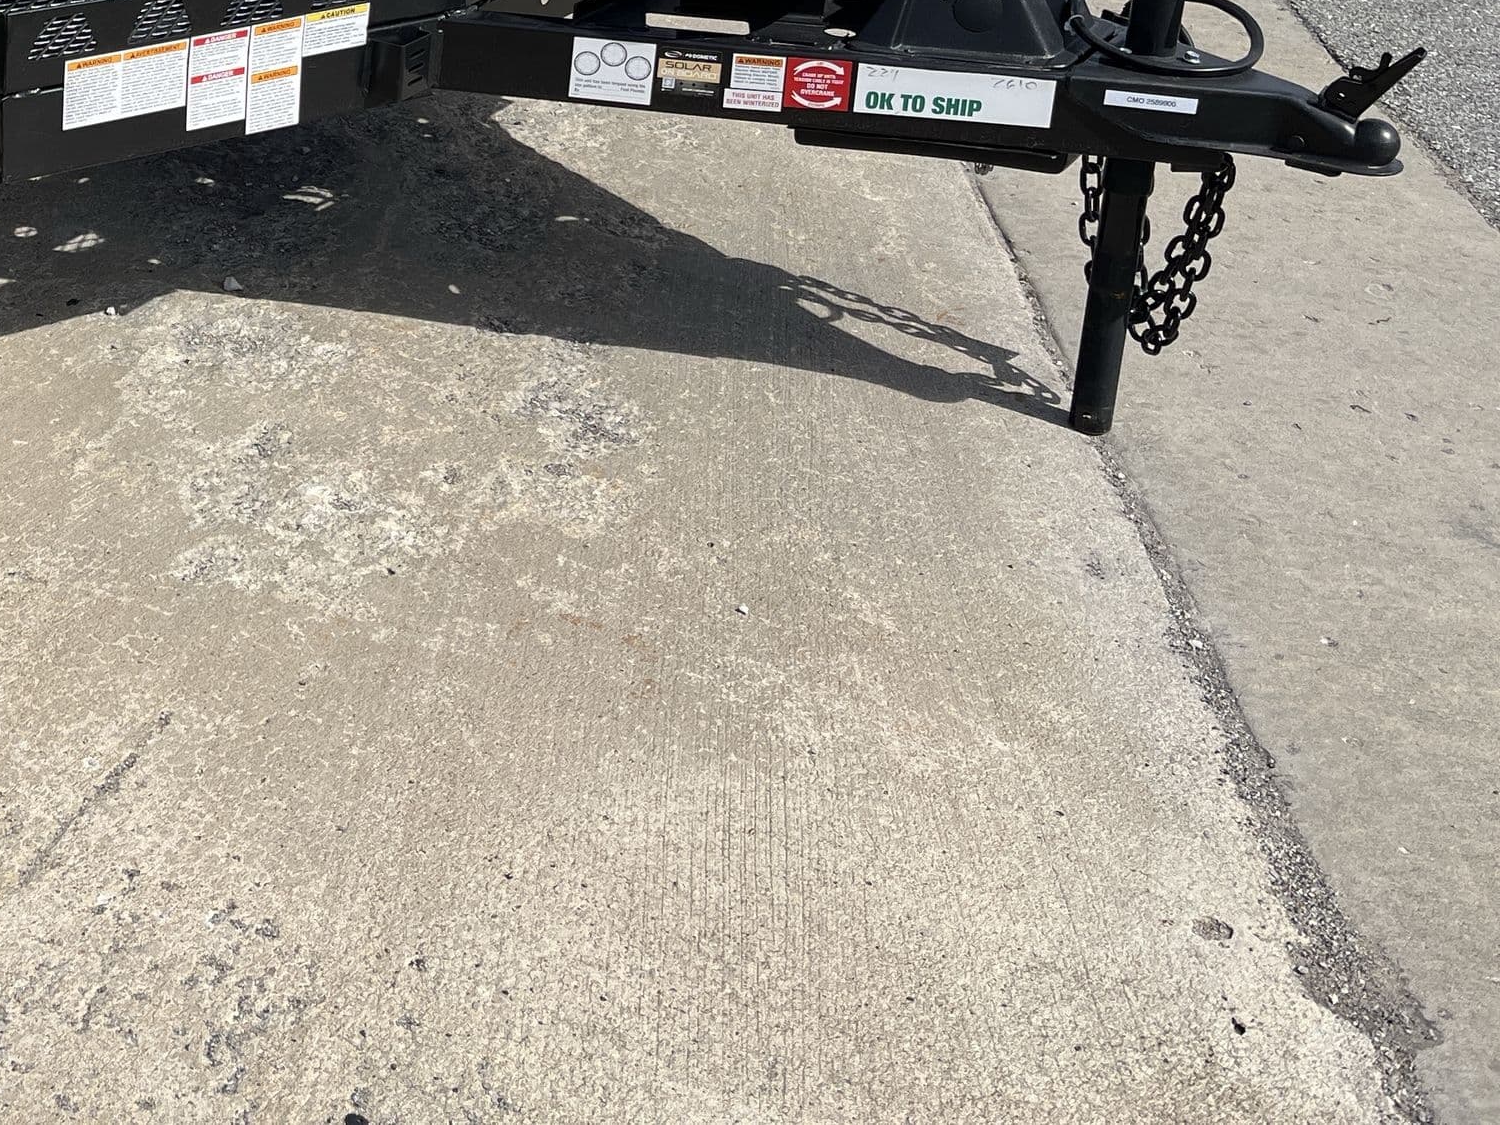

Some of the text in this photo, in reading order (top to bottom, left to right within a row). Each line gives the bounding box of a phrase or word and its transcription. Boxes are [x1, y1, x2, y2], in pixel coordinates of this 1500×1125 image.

[326, 7, 356, 19] CAUTION
[267, 21, 295, 32] WARNING
[209, 32, 237, 42] DANGER
[81, 57, 113, 69] WARNING
[665, 60, 712, 72] SOLAR
[745, 58, 781, 66] WARNING
[205, 70, 234, 81] DANGER
[263, 69, 291, 80] WARNING
[660, 67, 717, 80] ON BOARD
[743, 100, 780, 108] WINTERIZED
[865, 90, 982, 117] OK TO SHIP
